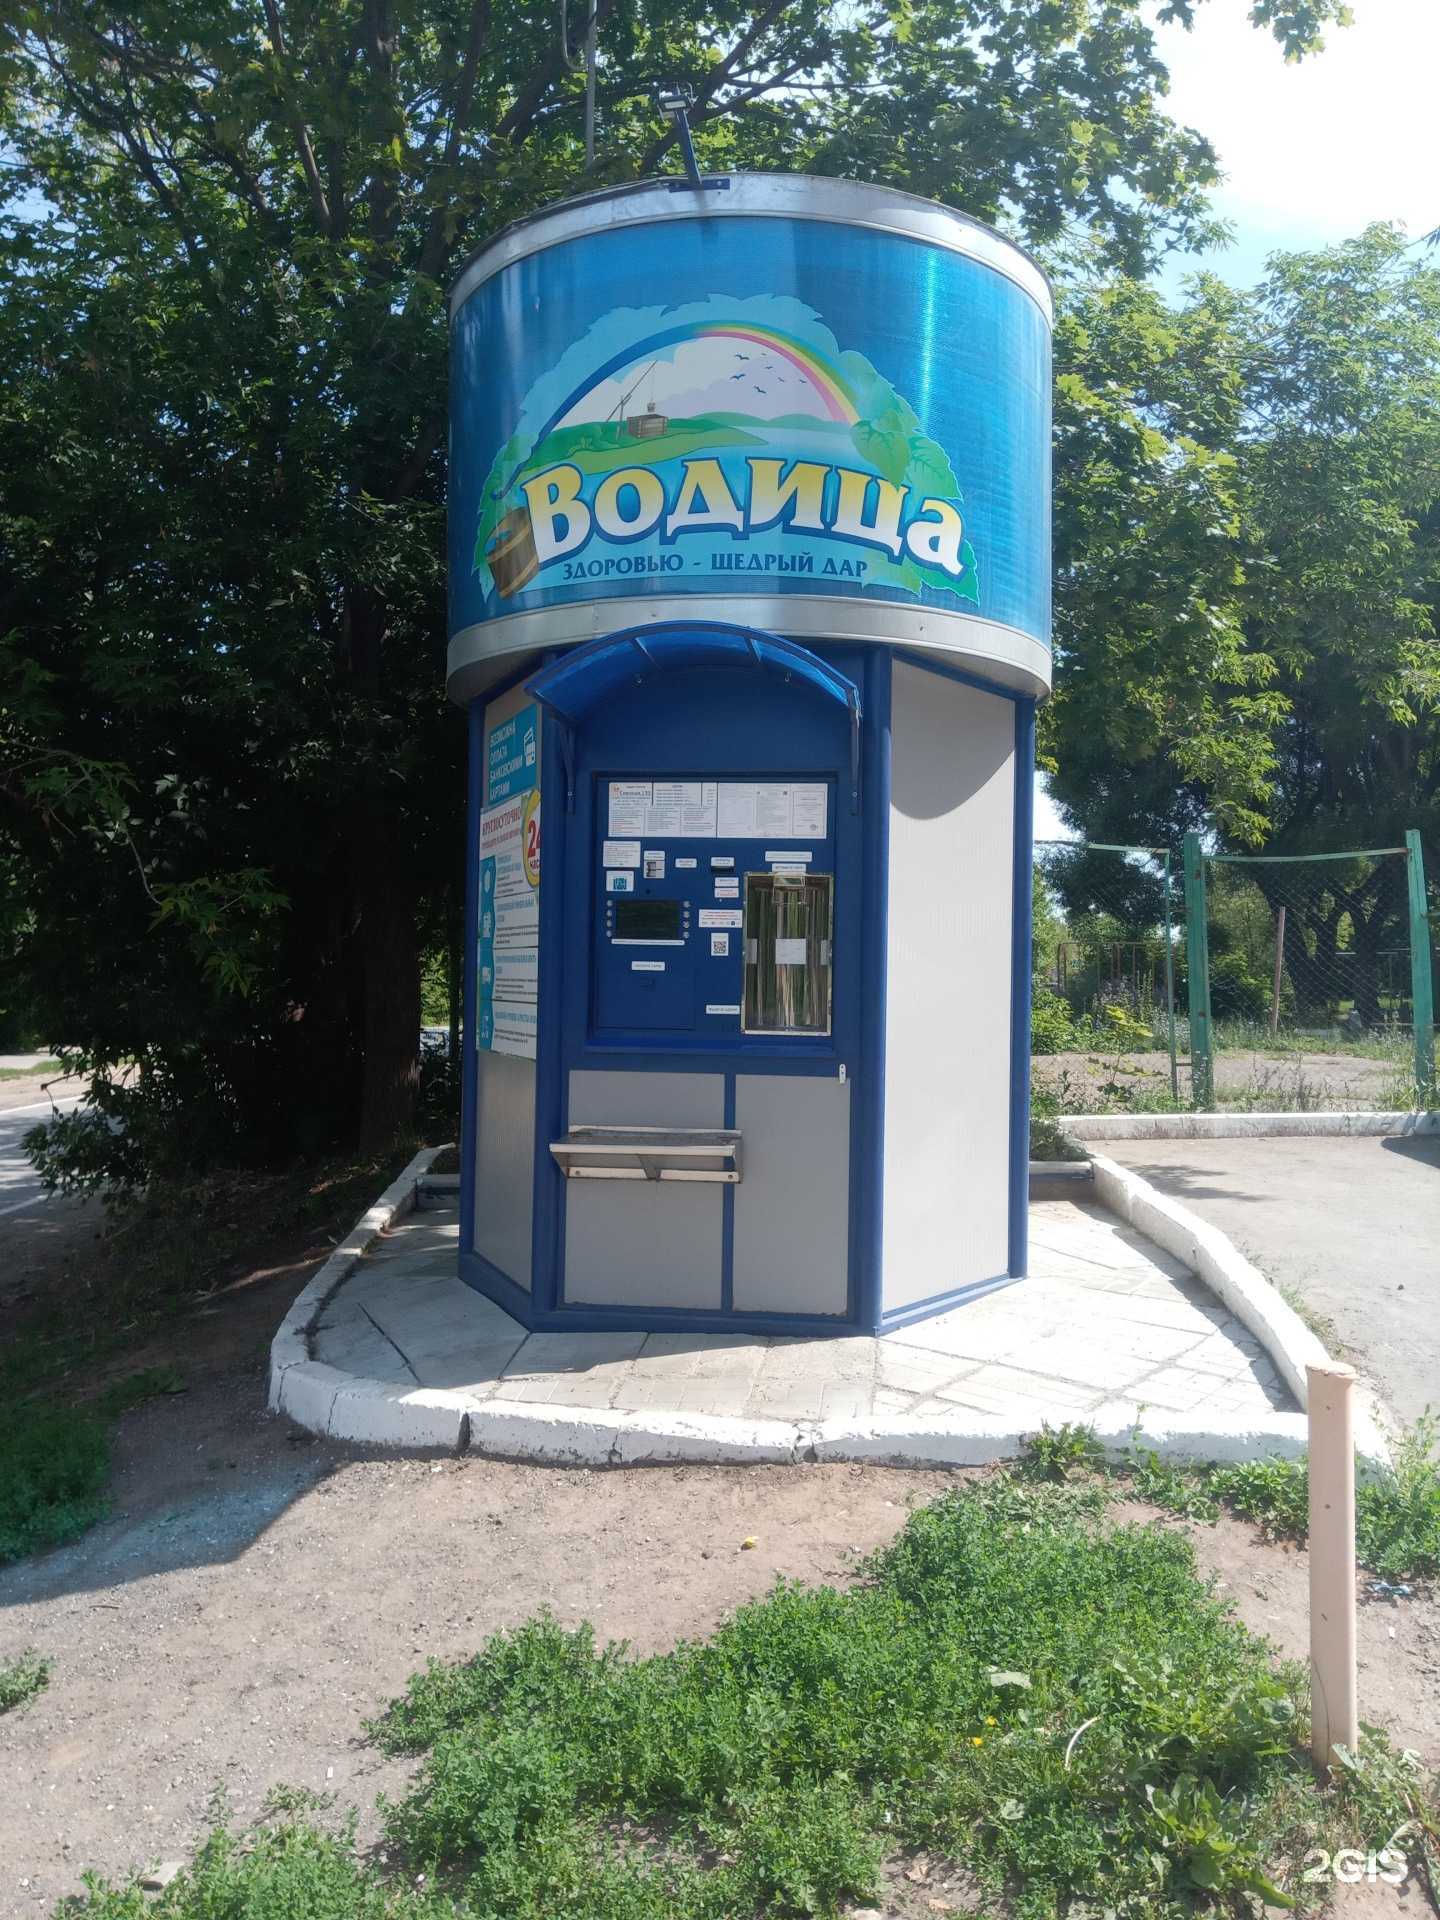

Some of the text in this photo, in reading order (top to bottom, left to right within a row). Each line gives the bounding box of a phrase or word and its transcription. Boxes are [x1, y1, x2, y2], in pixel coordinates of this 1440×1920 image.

[562, 553, 684, 581] ЗДОРОВЬЮ
[711, 552, 814, 573] ЩЕДРЫЙ
[822, 557, 868, 577] ДАР
